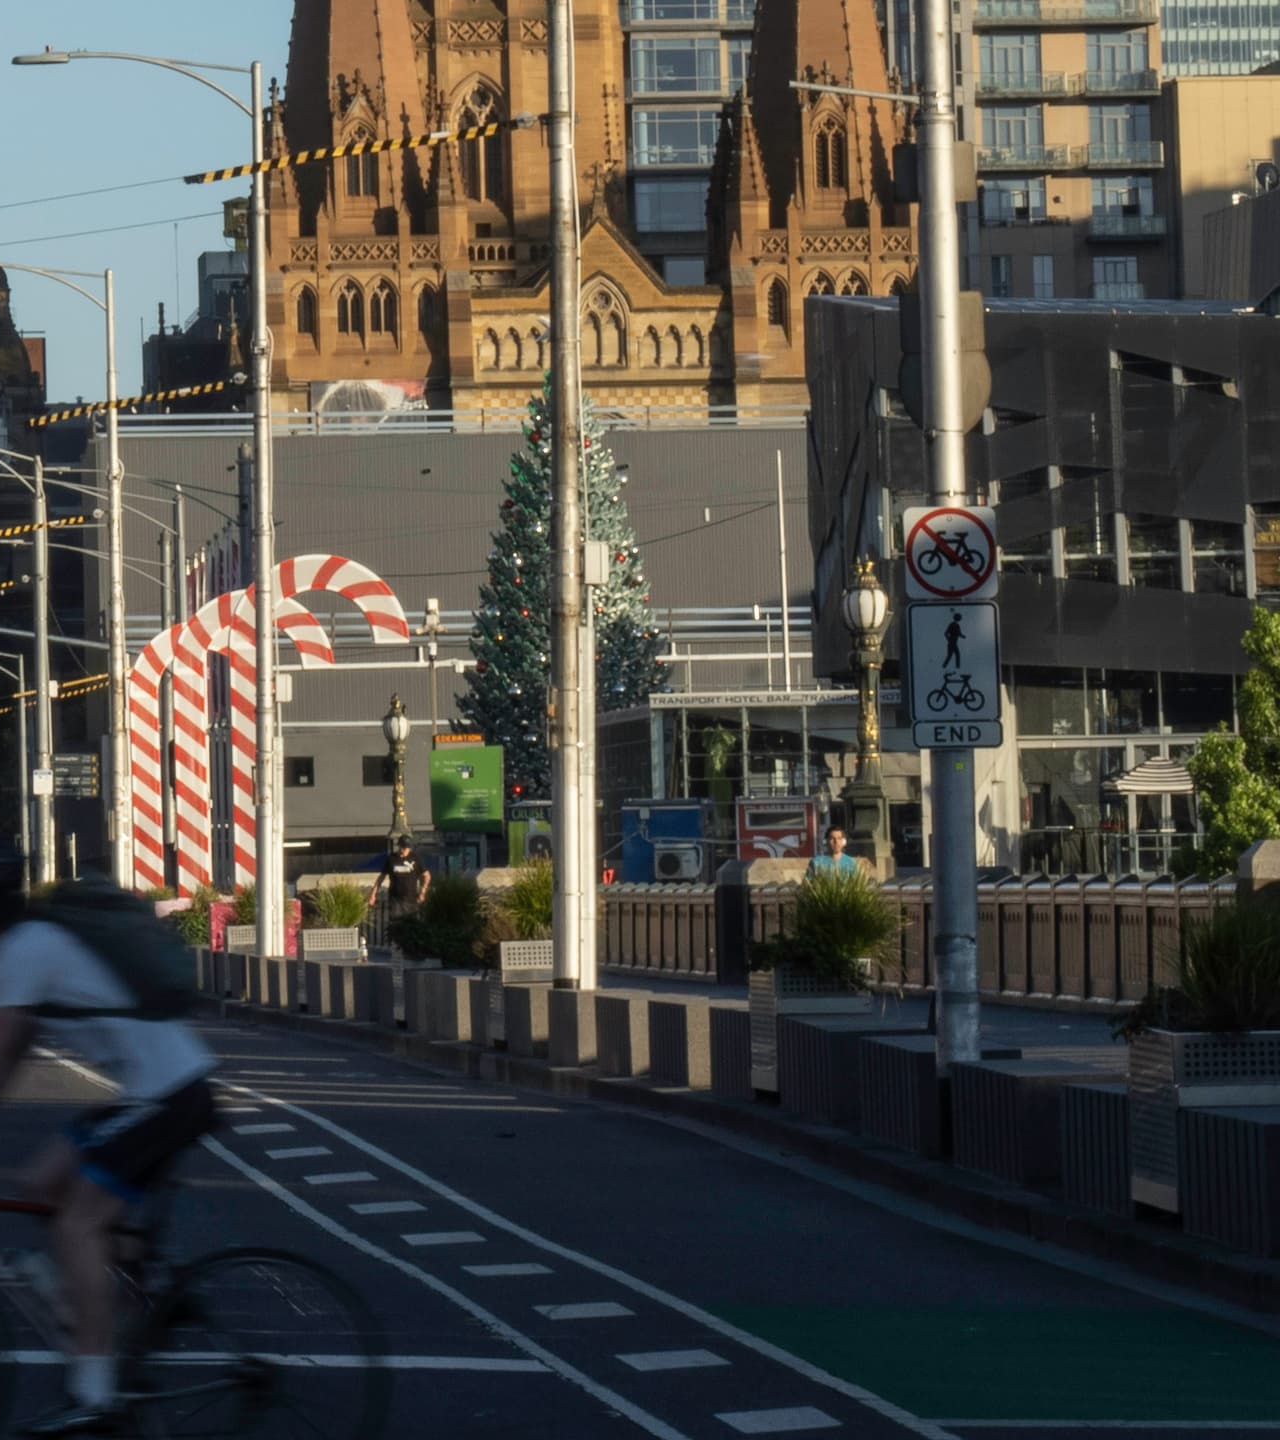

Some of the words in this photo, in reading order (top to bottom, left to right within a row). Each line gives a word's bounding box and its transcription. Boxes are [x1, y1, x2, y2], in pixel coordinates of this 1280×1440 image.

[652, 695, 722, 706] TRANSPORT
[725, 694, 763, 704] HOTEL
[767, 693, 791, 703] BAR
[934, 726, 982, 742] END
